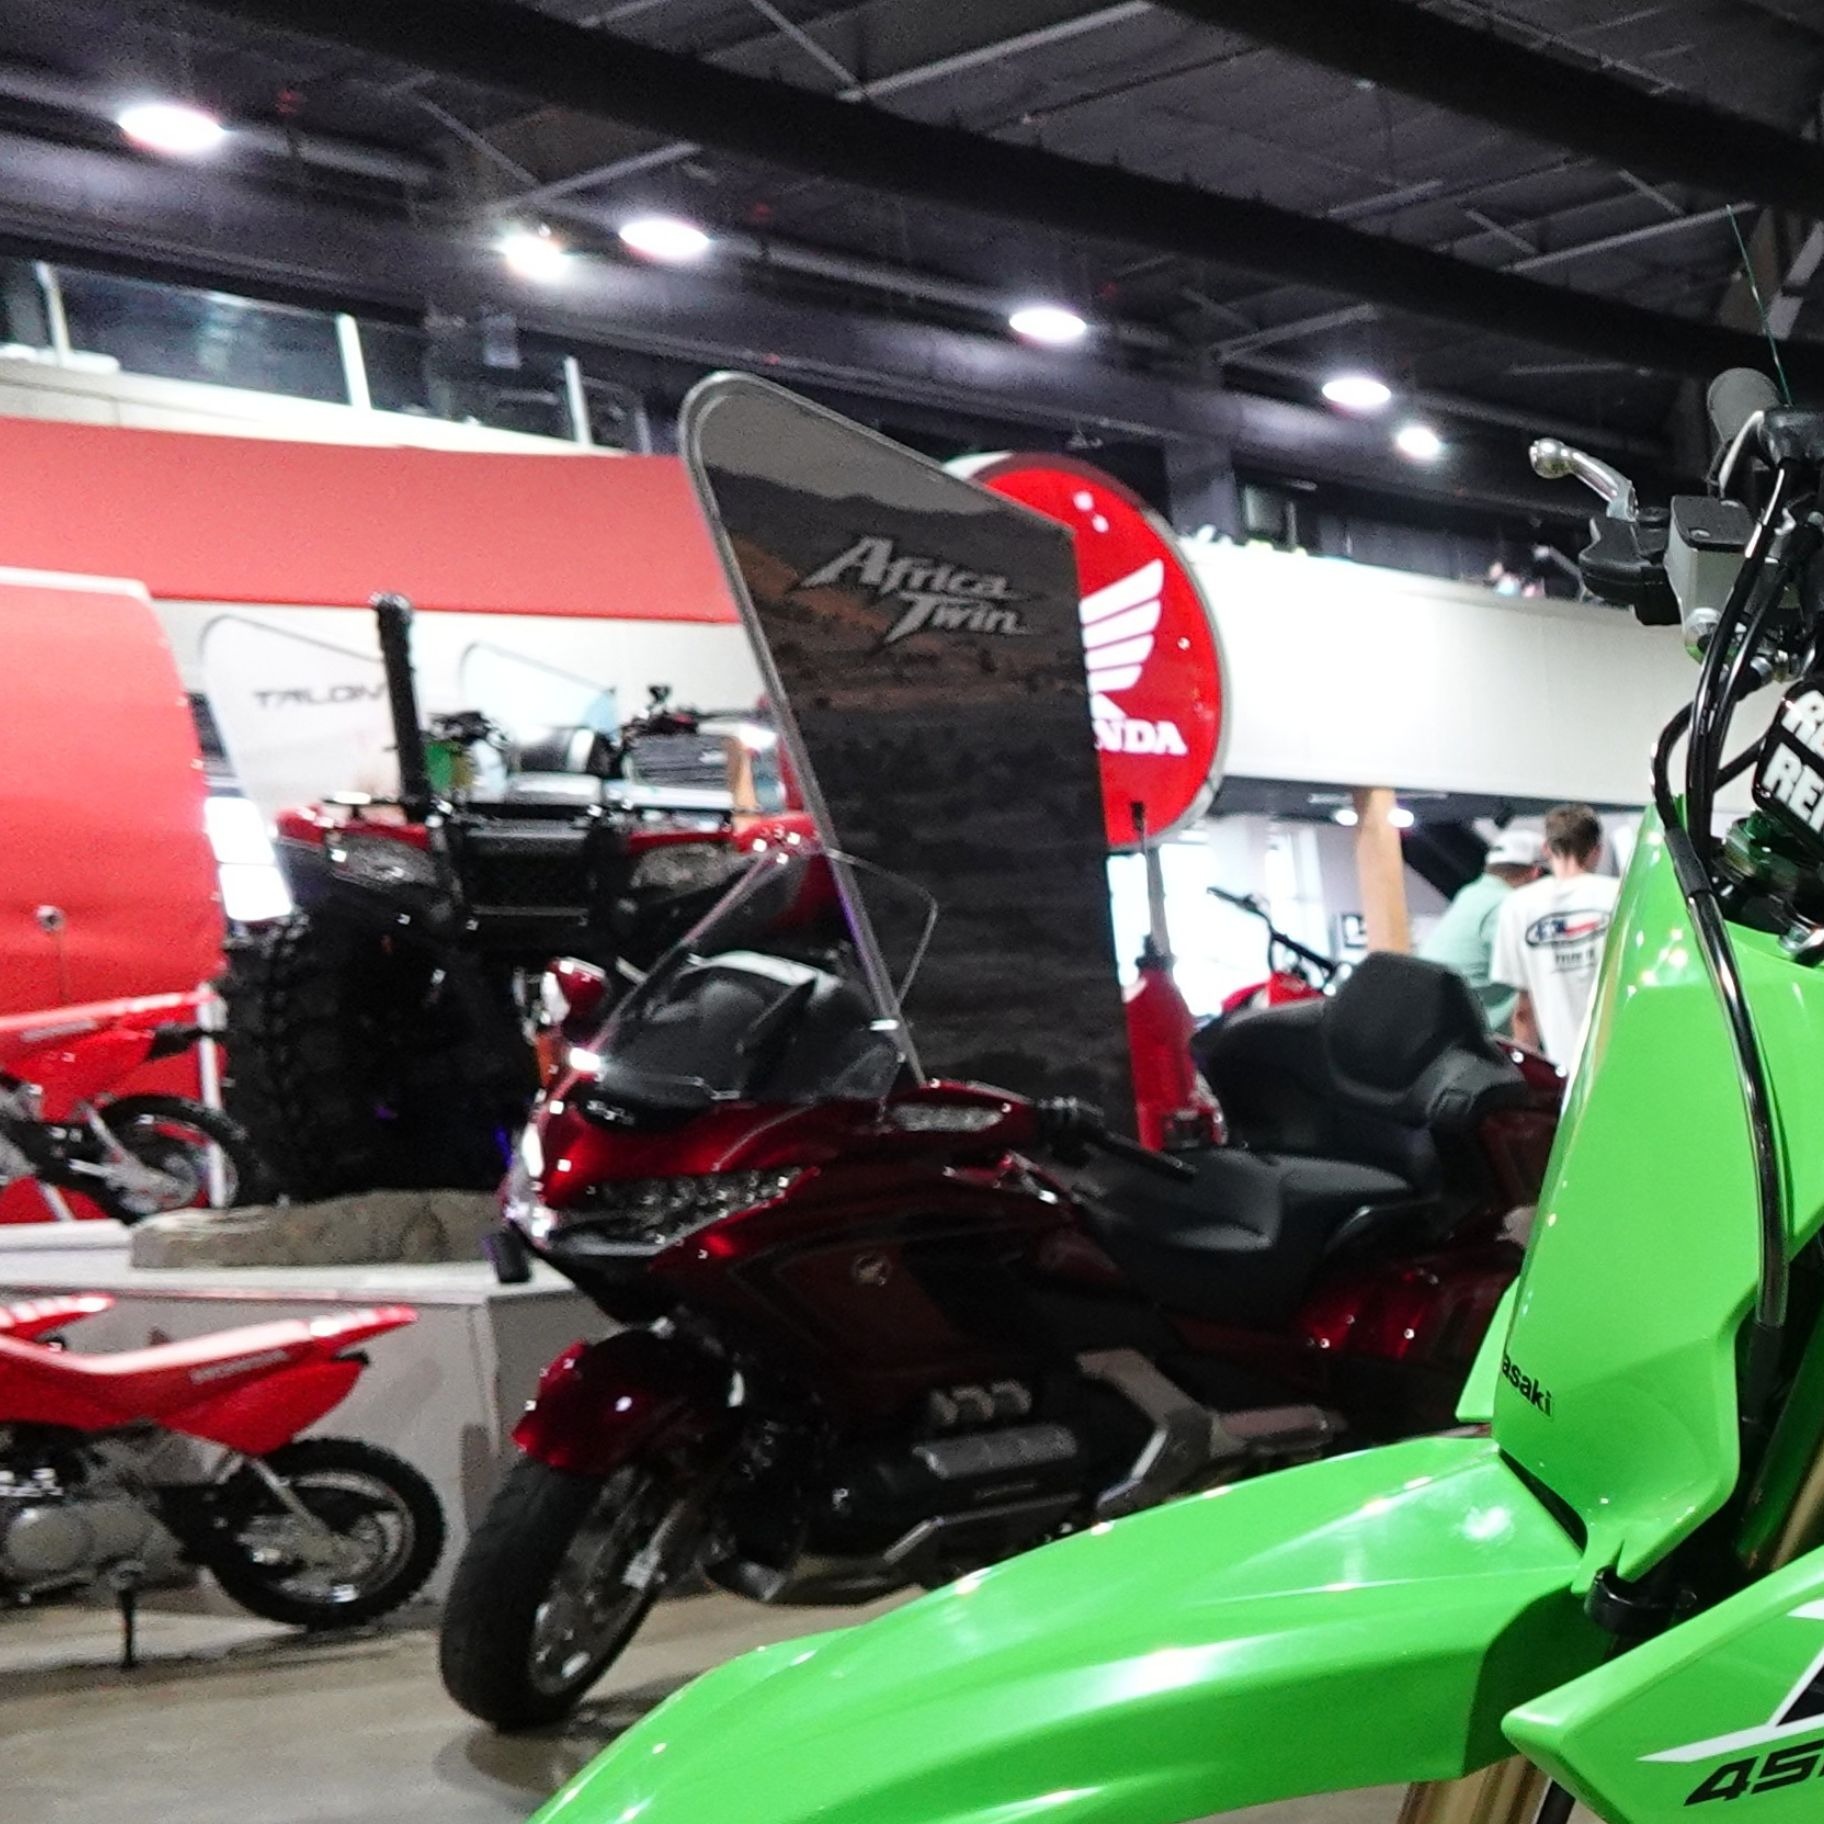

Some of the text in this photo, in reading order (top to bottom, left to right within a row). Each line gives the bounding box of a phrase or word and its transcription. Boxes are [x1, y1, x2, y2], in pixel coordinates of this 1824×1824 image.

[801, 535, 1014, 597] Africa
[884, 590, 1032, 643] Twin
[1093, 718, 1188, 756] NDA
